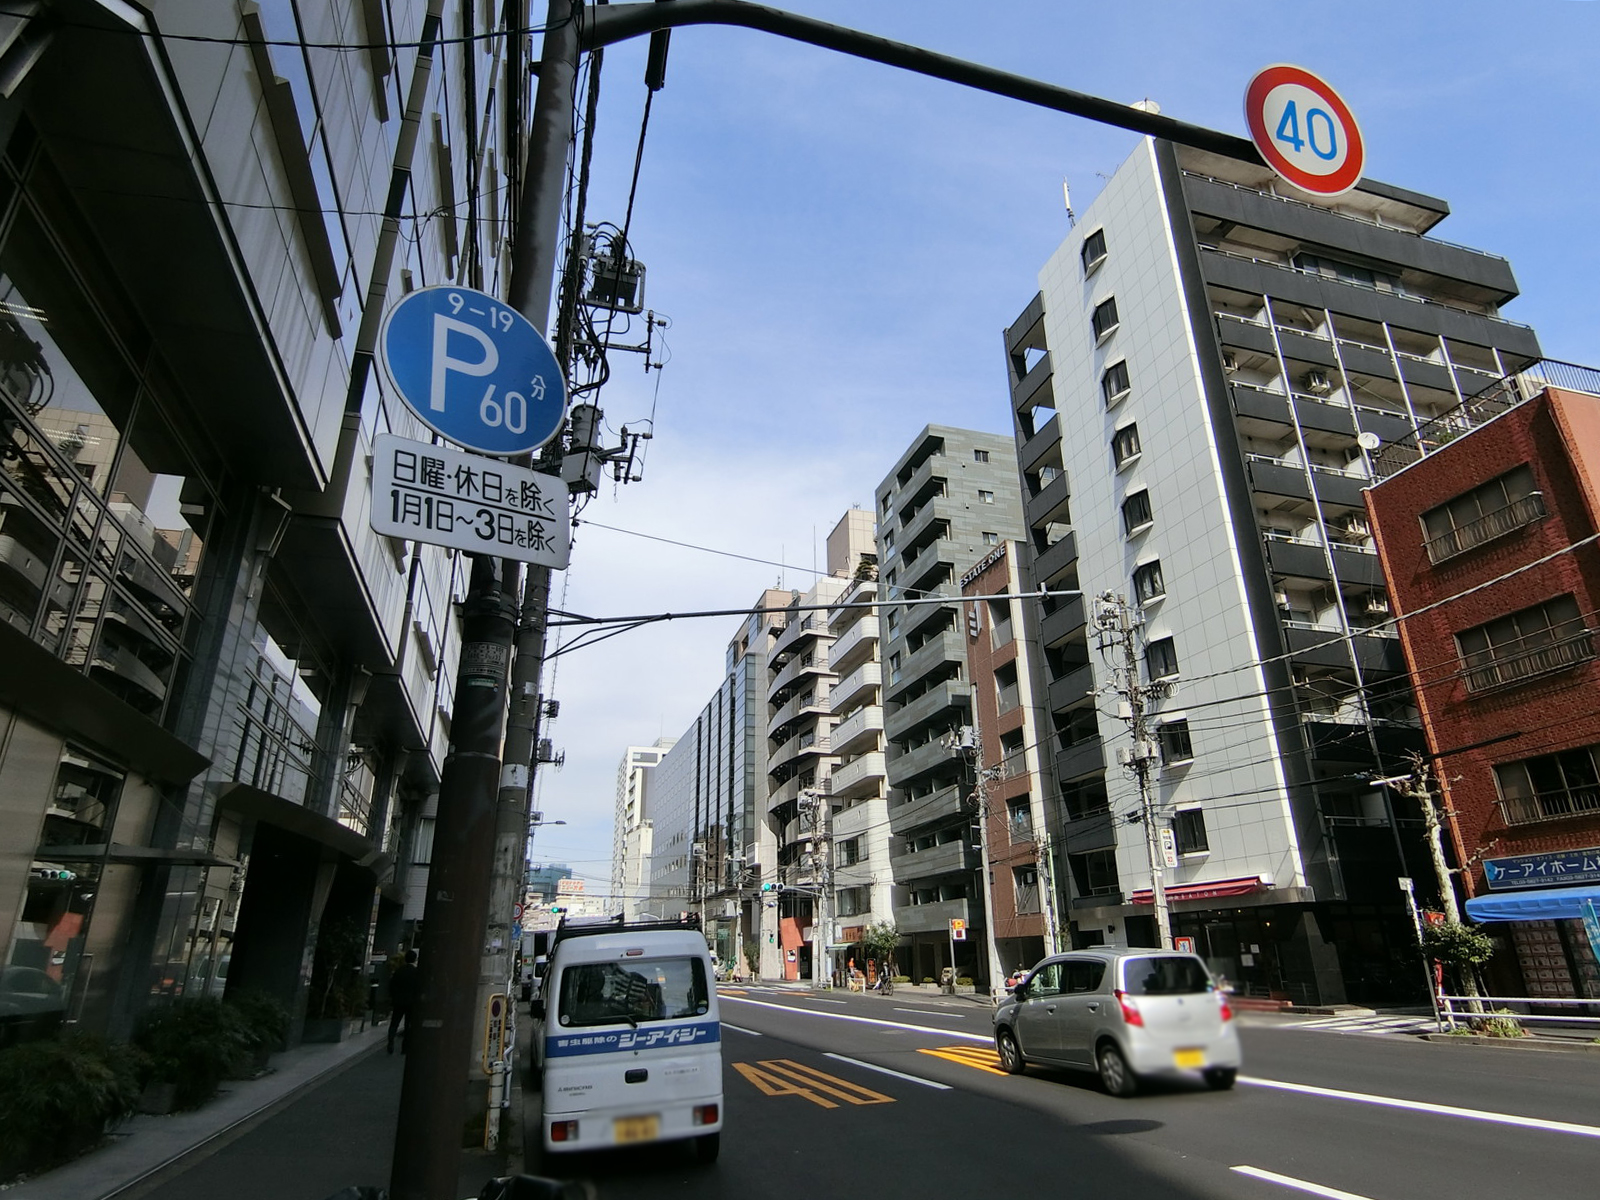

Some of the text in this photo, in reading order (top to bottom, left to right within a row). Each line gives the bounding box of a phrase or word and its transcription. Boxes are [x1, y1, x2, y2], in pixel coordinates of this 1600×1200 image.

[1276, 100, 1337, 160] 40
[448, 292, 514, 333] 9-19
[430, 312, 499, 413] P
[393, 449, 555, 515] 日曜・休日を除く
[391, 488, 556, 554] 1月1日～3日を除く
[960, 545, 1006, 588] ESTATE ONE
[955, 920, 963, 930] P
[557, 1035, 617, 1047] 害虫駆除の
[731, 1059, 898, 1109] 40
